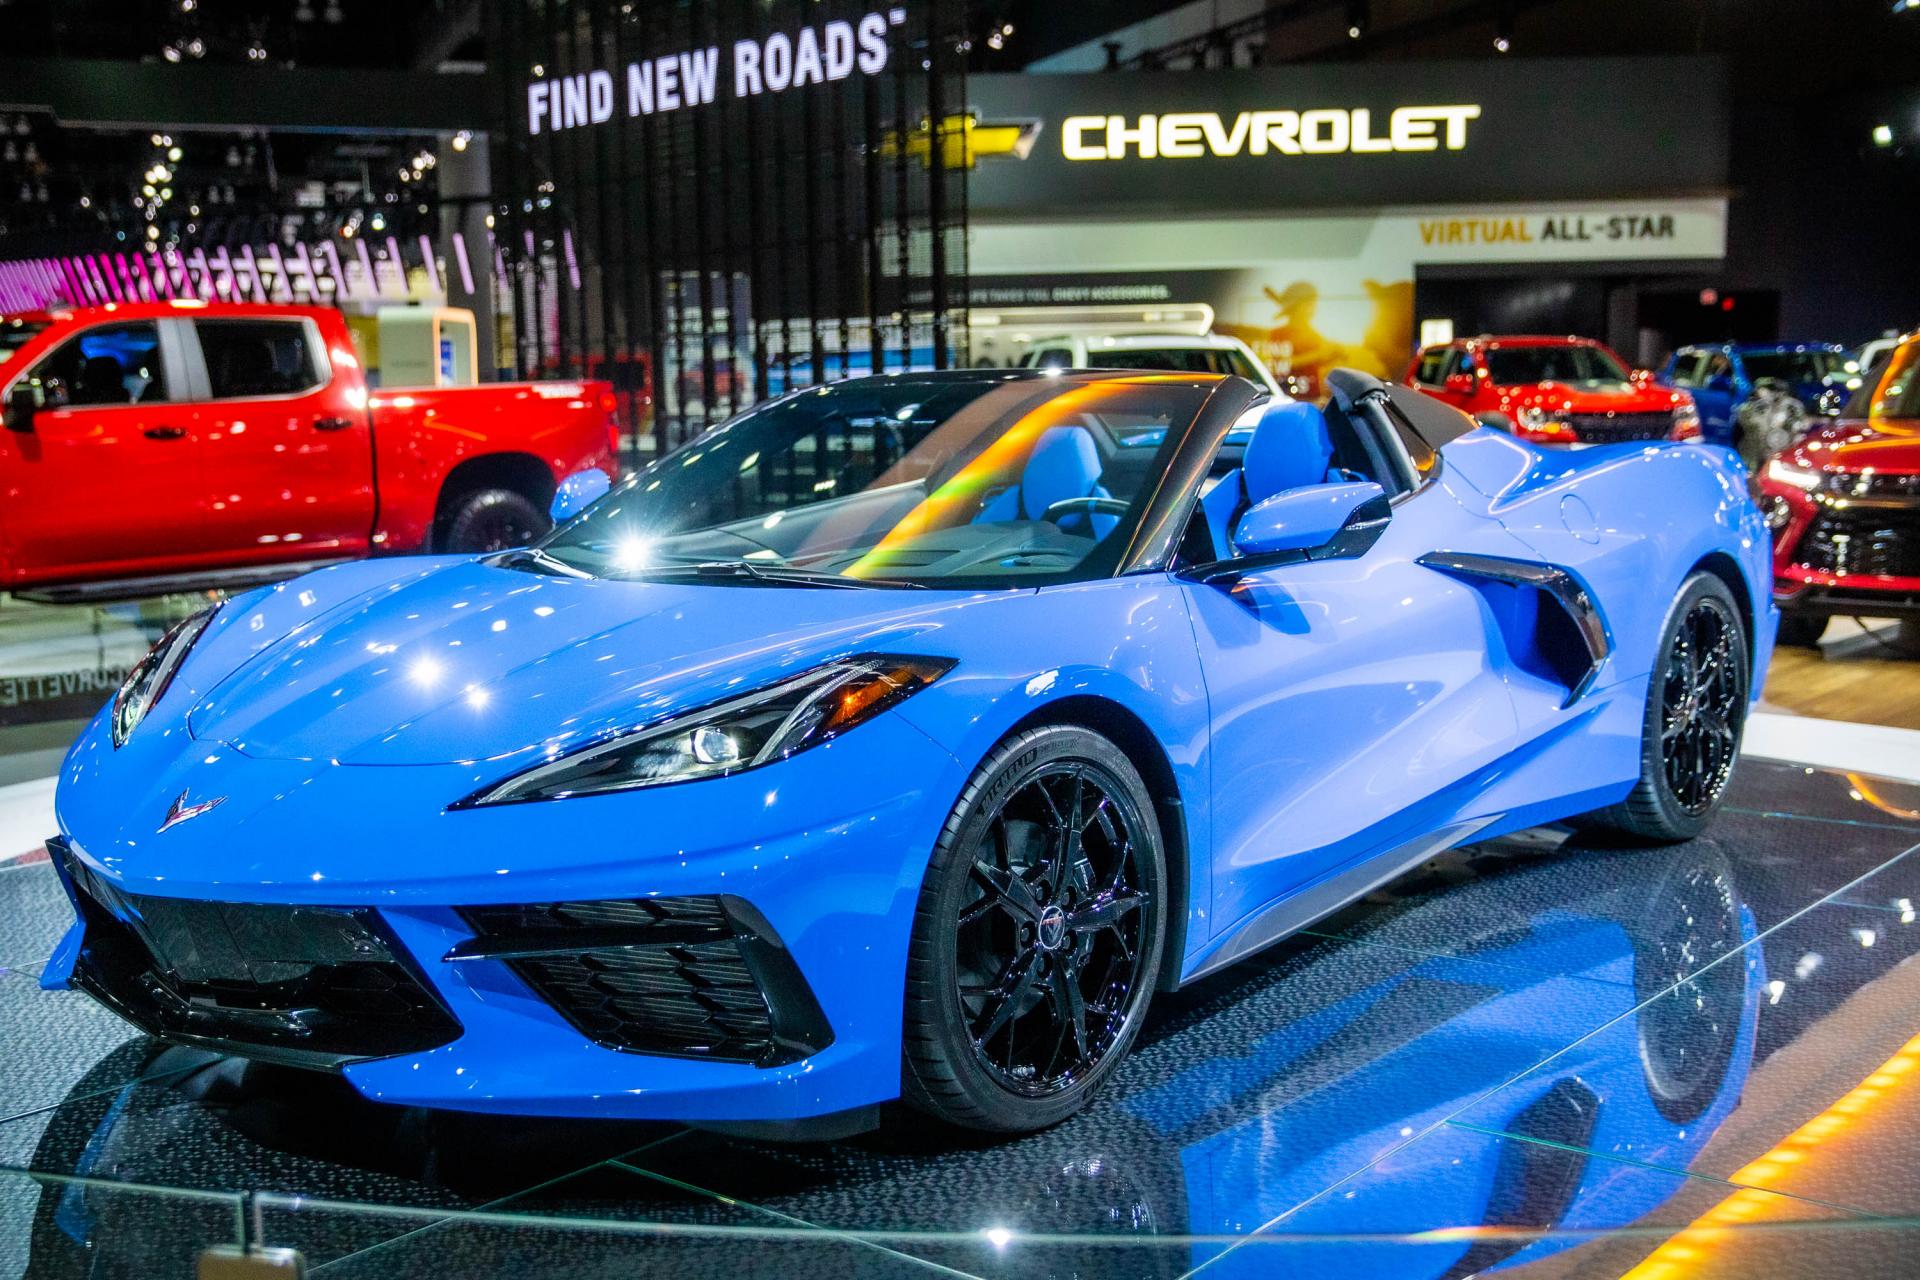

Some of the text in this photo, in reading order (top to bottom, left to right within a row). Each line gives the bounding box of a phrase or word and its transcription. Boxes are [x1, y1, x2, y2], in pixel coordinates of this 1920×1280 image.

[527, 69, 614, 135] FIND
[626, 46, 719, 117] NEW
[1061, 104, 1481, 160] CHEVROLET
[1420, 215, 1674, 245] VIRTUAL ALL-STAR
